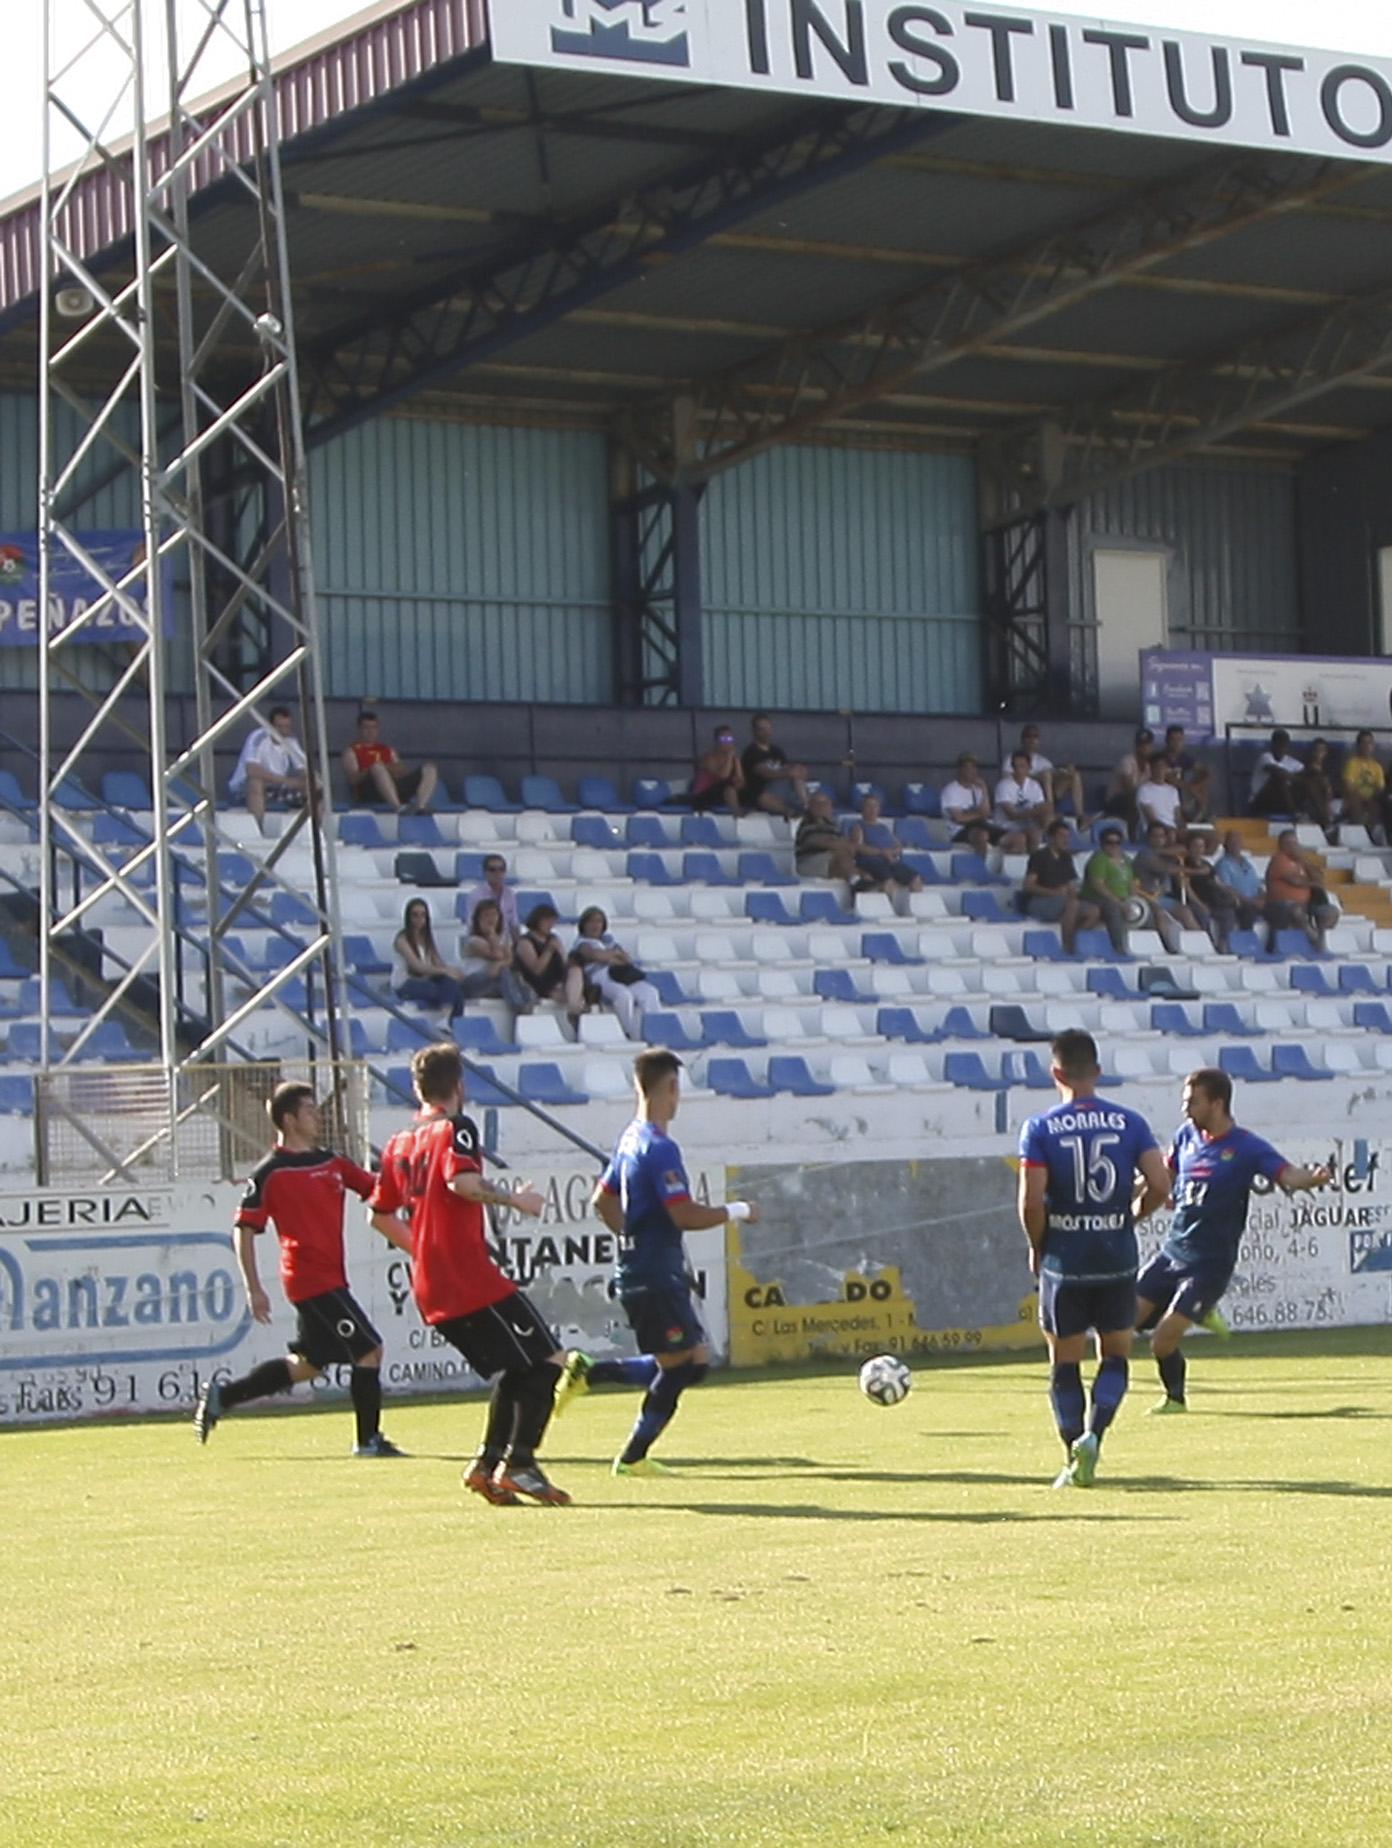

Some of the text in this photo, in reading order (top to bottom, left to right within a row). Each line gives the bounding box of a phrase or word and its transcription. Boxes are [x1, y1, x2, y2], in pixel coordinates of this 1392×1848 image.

[1046, 1111, 1127, 1135] MORALES
[1059, 1132, 1121, 1204] 15
[1289, 1205, 1371, 1229] JAGUAR
[774, 1320, 798, 1335] Las
[389, 1360, 457, 1384] CAMINO
